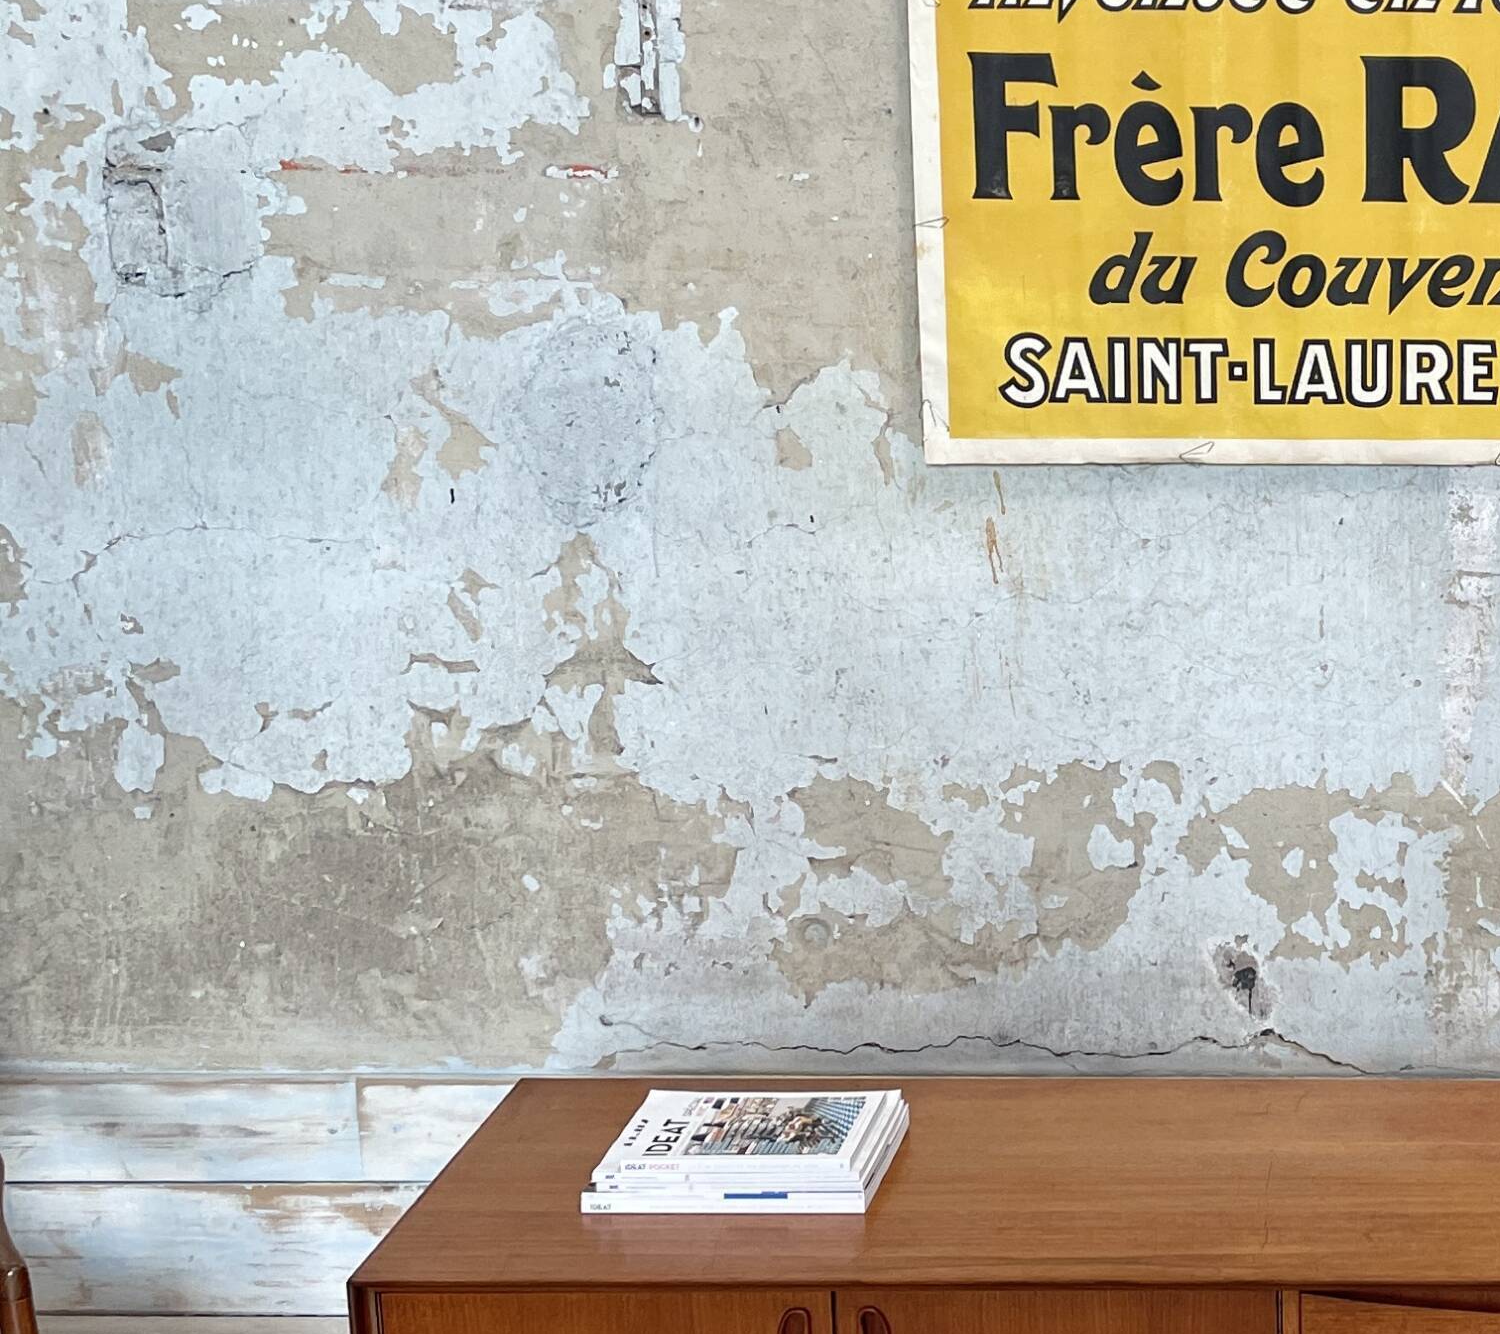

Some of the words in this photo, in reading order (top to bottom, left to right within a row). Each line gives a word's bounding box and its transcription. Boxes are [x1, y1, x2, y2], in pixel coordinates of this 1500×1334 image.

[966, 51, 1325, 208] Frère
[1088, 230, 1198, 305] du
[641, 1118, 690, 1156] IDEAT
